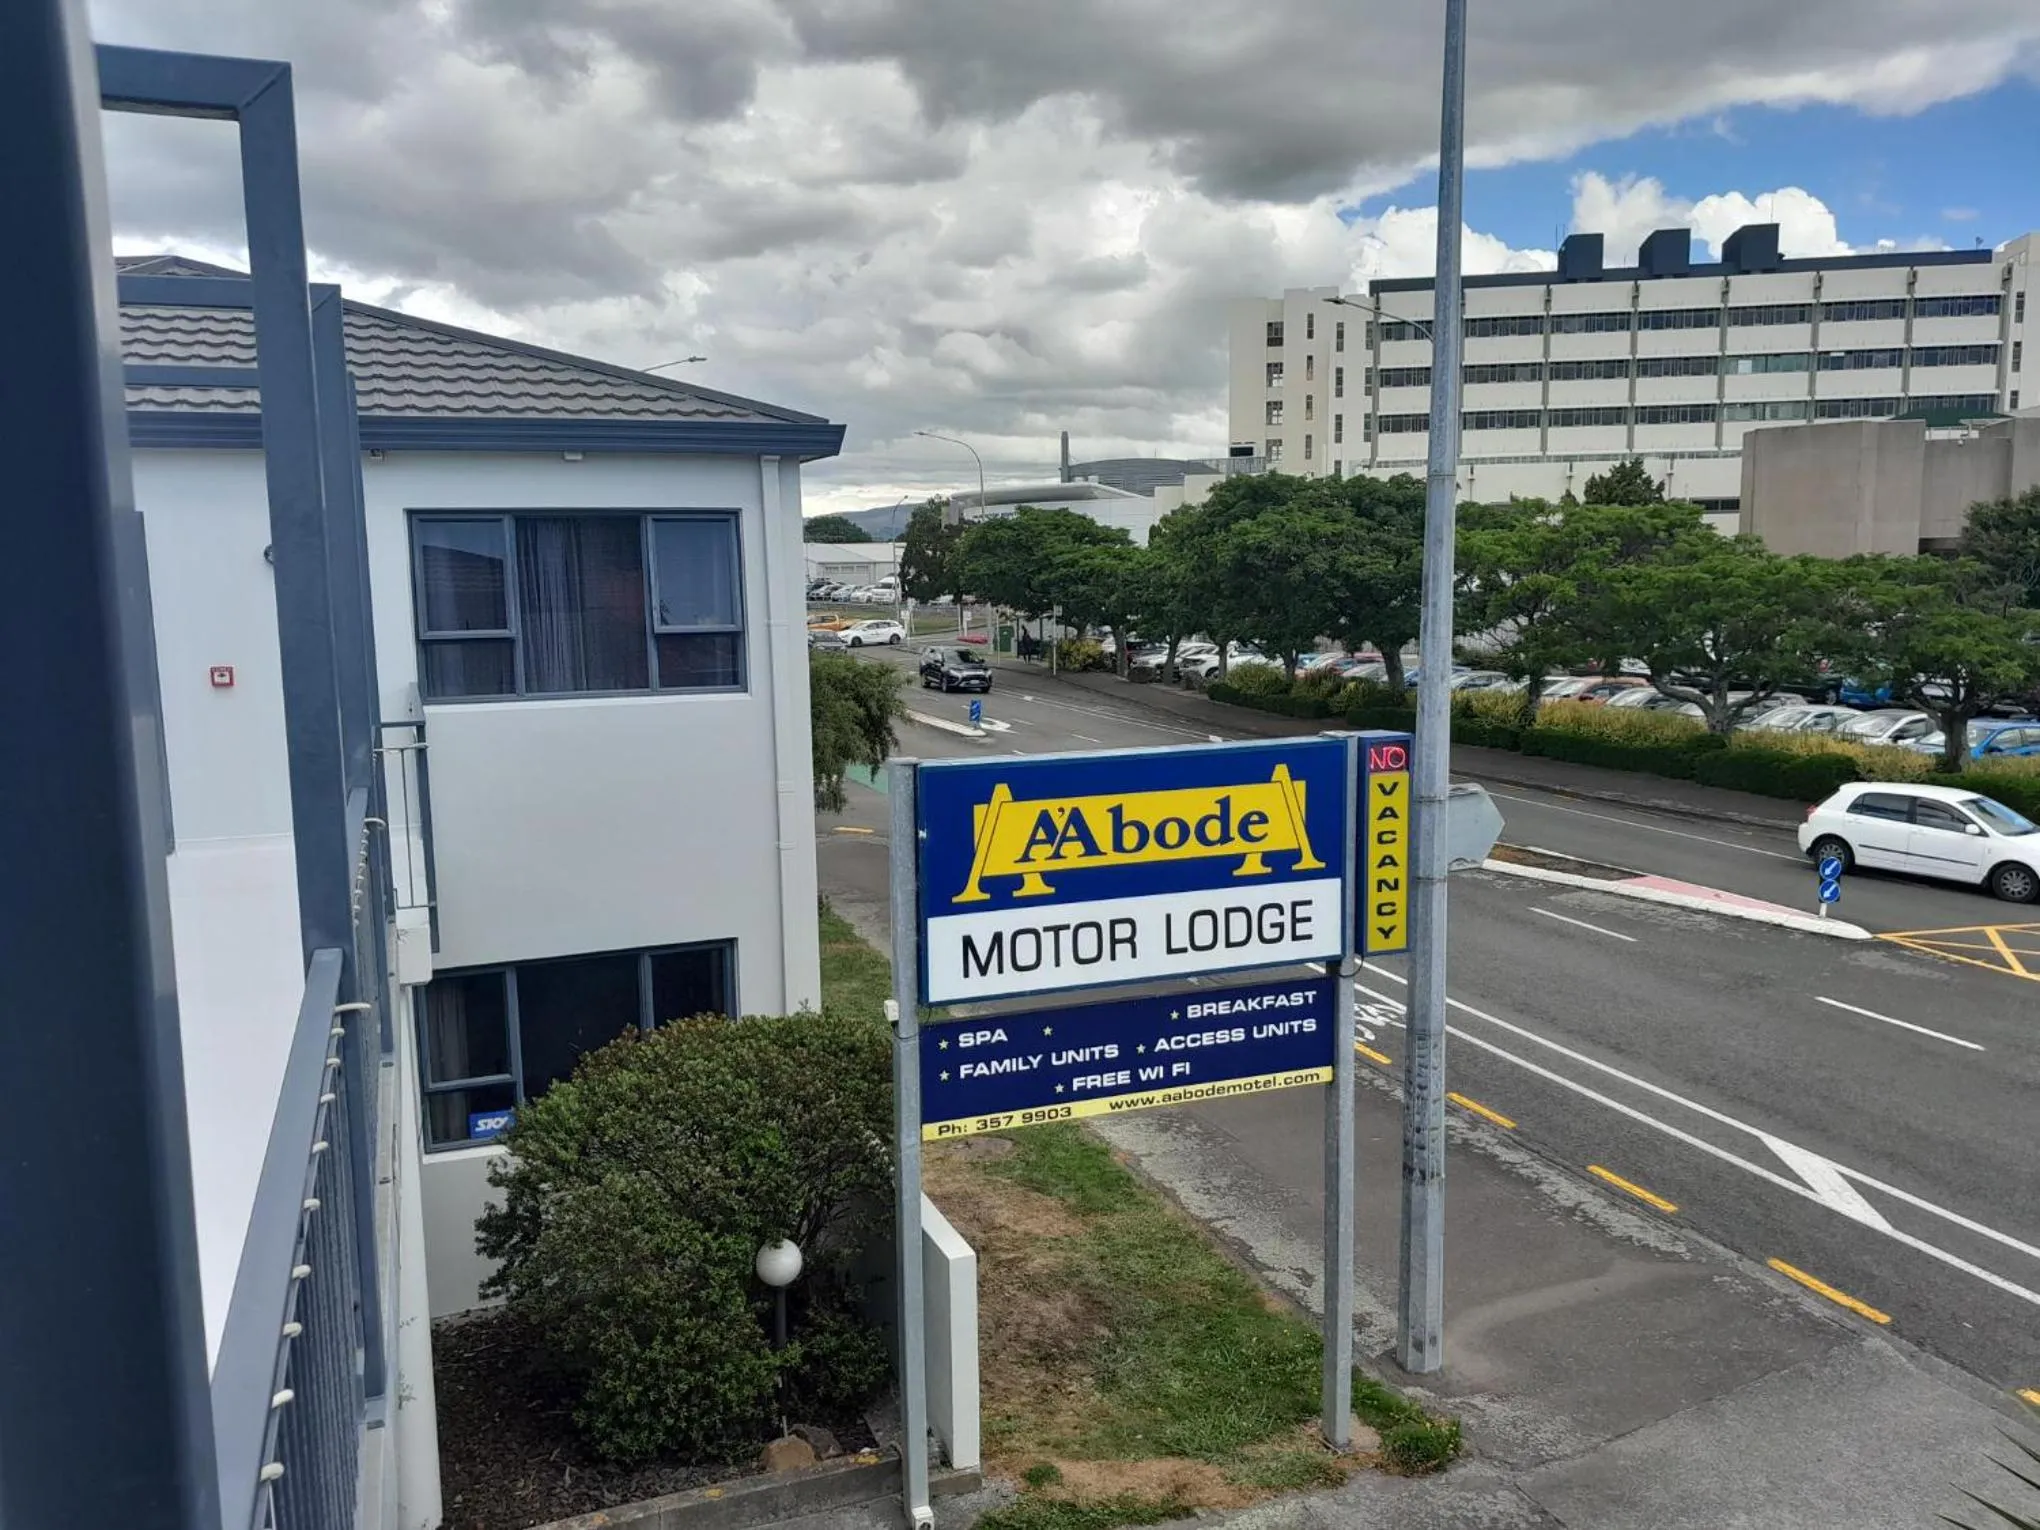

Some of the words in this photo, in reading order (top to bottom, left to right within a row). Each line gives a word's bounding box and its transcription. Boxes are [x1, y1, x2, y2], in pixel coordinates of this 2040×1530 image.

[1370, 746, 1406, 770] NO
[1376, 781, 1400, 940] VACANCY
[961, 917, 1138, 979] MOTOR
[1164, 899, 1314, 956] LODGE
[1186, 990, 1317, 1019] BREAKFAST
[958, 1028, 1009, 1048] SPA
[1154, 1027, 1246, 1053] ACCESS
[1252, 1018, 1317, 1039] UNITS
[959, 1053, 1044, 1079] FAMILY
[1051, 1043, 1119, 1066] UNITS
[1072, 1070, 1131, 1092] FREE
[1138, 1064, 1165, 1081] WI
[1171, 1060, 1191, 1077] FI
[1108, 1070, 1320, 1111] www.aabodemotel.com
[937, 1124, 968, 1136] Ph:
[976, 1115, 1014, 1131] 357
[1021, 1106, 1073, 1124] 9903
